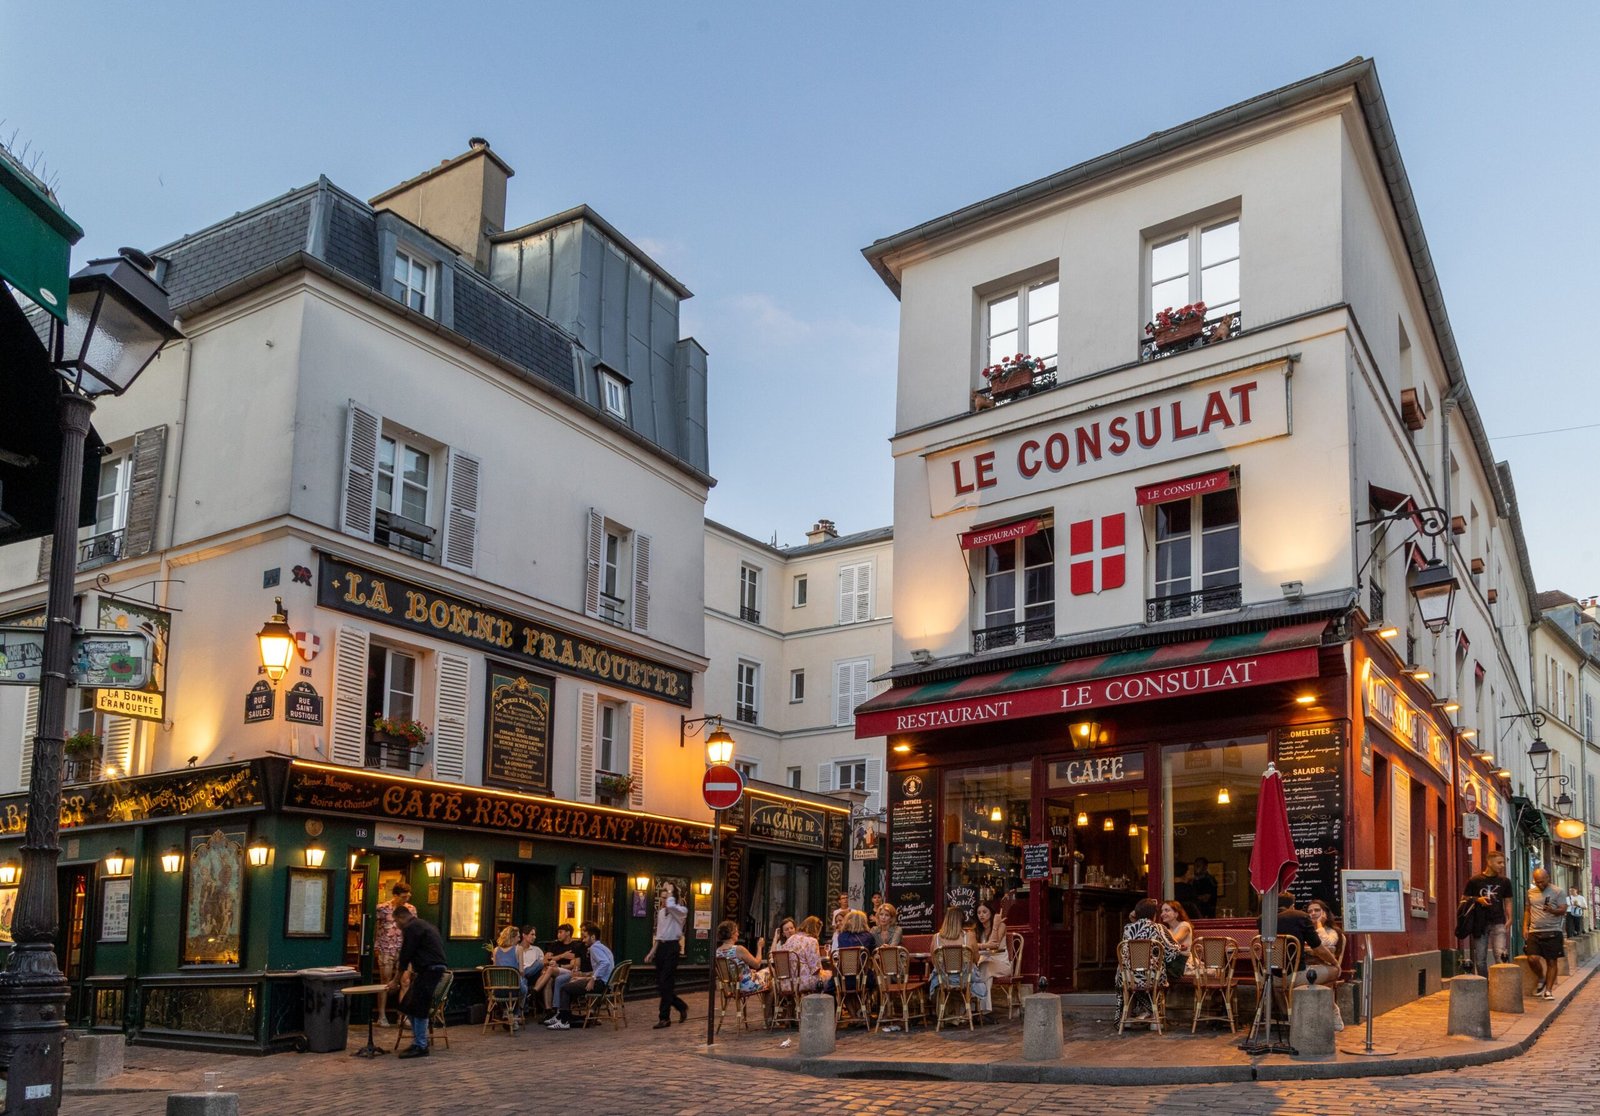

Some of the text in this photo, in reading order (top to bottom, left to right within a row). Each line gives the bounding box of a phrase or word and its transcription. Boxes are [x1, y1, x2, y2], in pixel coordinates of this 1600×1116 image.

[952, 381, 1257, 496] LE CONSULAT
[1147, 476, 1218, 501] LE CONSULAT
[972, 525, 1026, 545] RESTAURANT
[343, 571, 678, 696] LA BONNE FRANQUETTE
[100, 696, 159, 716] FRANQUETTE
[123, 691, 154, 705] BONNE
[253, 696, 266, 704] RUE
[298, 697, 311, 706] RUE
[896, 661, 1258, 731] RESTAURANT LE CONSULAT
[248, 708, 271, 719] SAULES
[289, 711, 319, 721] RUSTIQUE
[295, 704, 313, 713] SAINT
[1290, 727, 1331, 738] OMELETTES
[1292, 766, 1325, 776] SALADES
[178, 790, 206, 812] Boire
[383, 785, 462, 822] CAFÉ
[472, 796, 634, 841] RESTAURANT
[642, 820, 683, 848] VINS
[762, 811, 815, 832] LA CAVE DE
